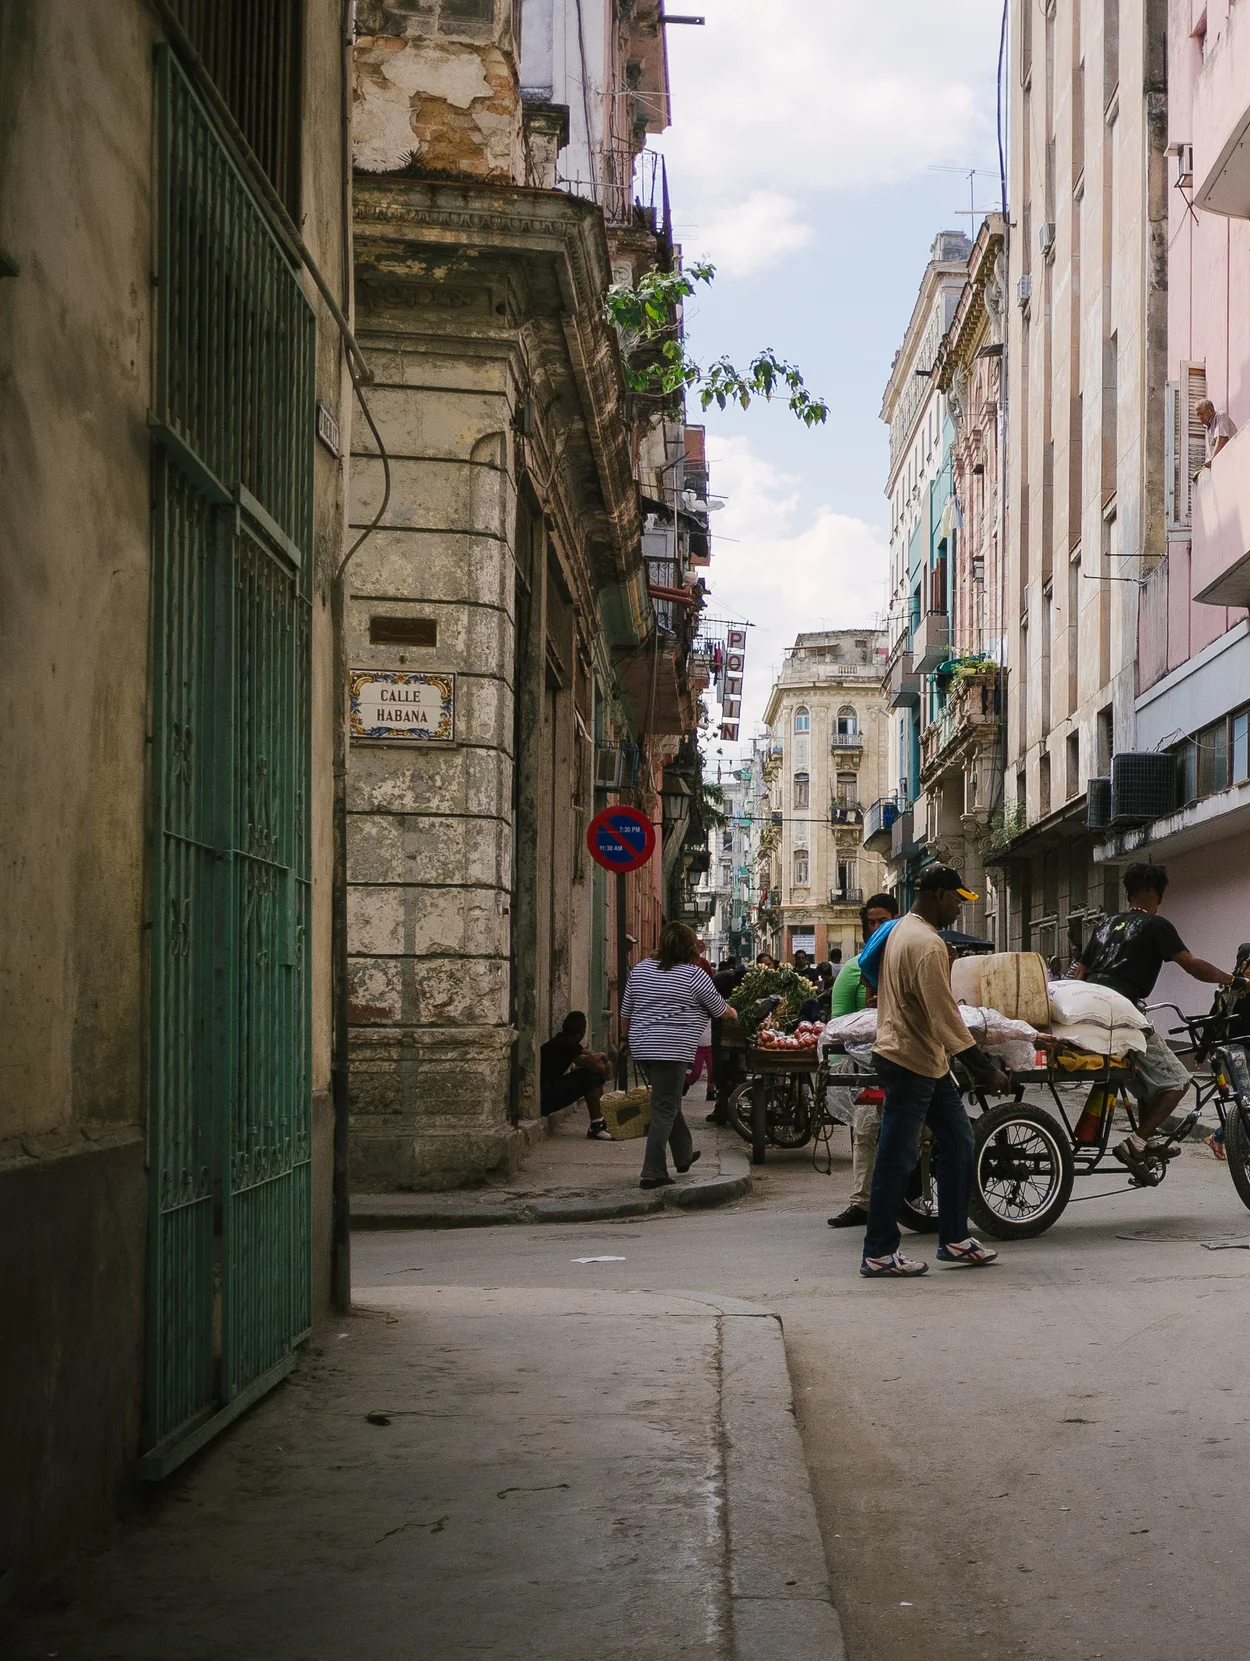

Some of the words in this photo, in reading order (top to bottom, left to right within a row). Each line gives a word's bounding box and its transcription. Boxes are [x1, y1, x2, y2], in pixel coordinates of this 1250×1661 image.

[723, 632, 743, 740] POTIN
[381, 690, 420, 702] CALLE
[377, 709, 428, 722] HABANA
